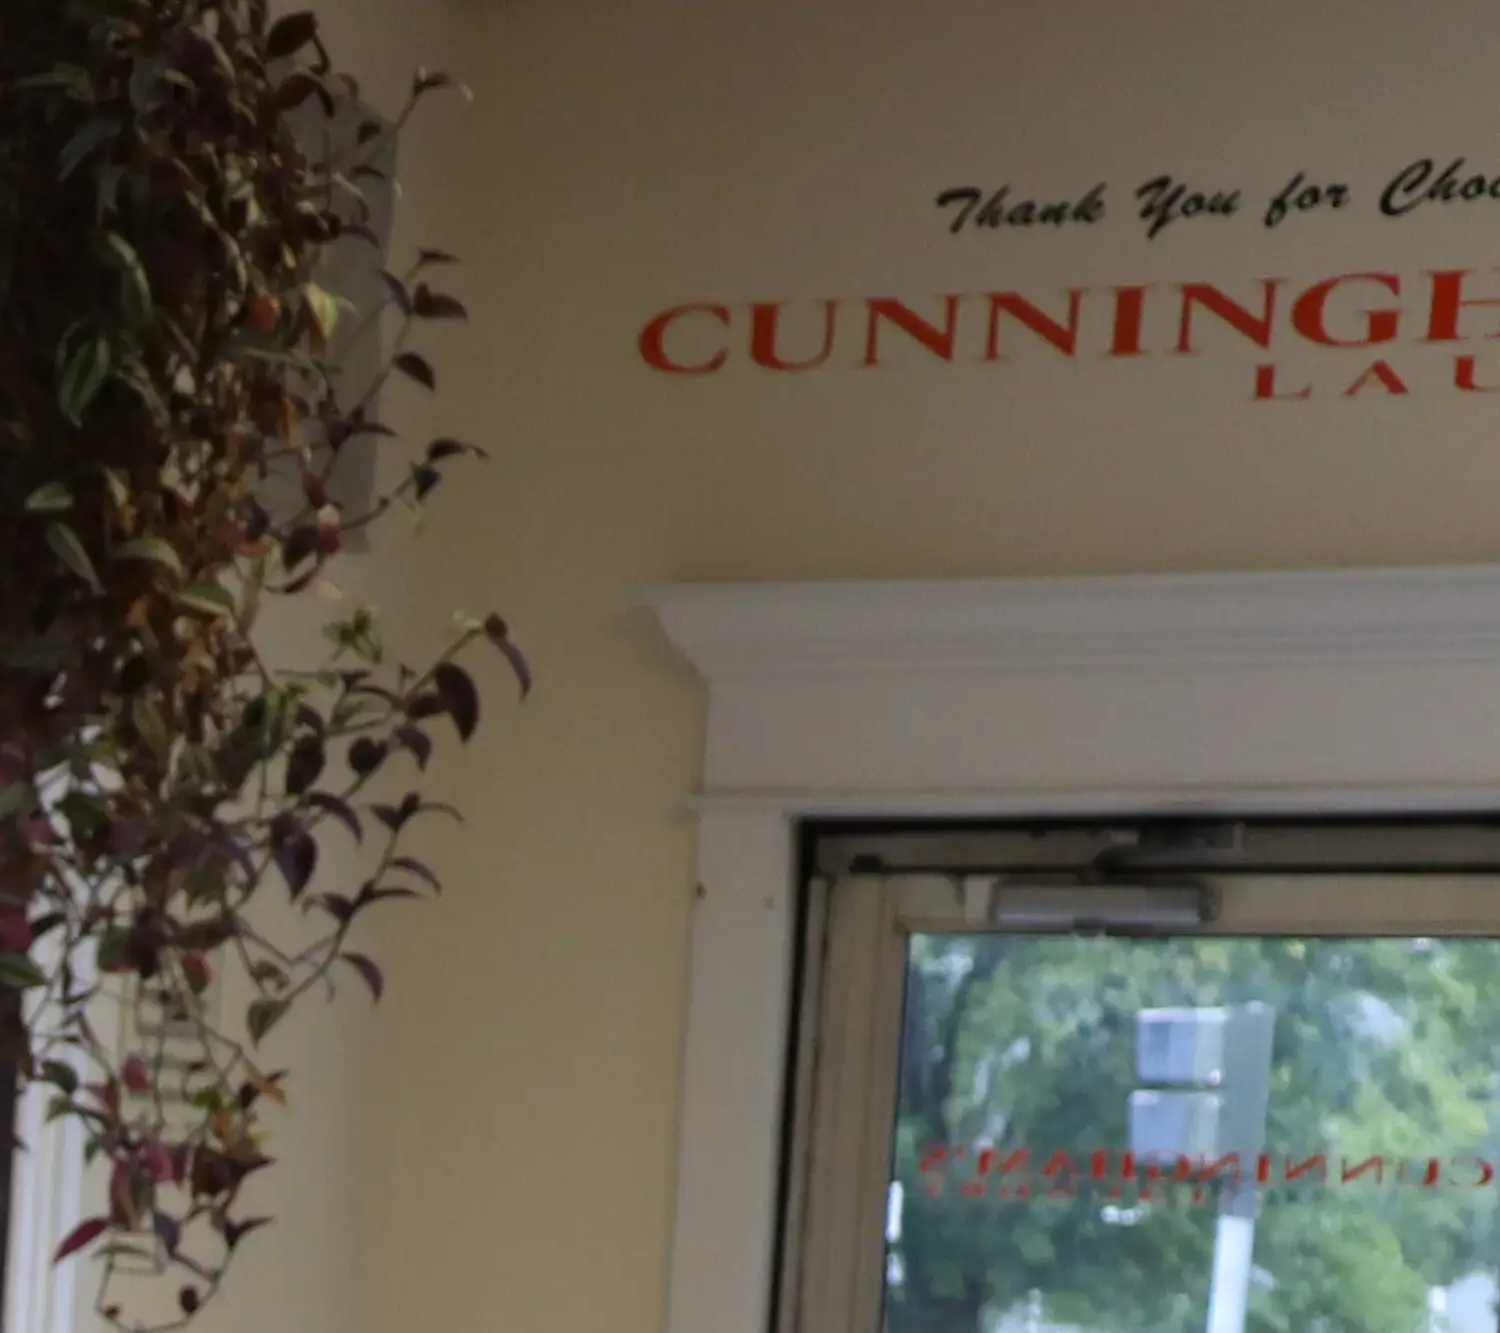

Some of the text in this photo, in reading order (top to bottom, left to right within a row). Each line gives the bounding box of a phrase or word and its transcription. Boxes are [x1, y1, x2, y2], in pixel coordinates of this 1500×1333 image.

[936, 183, 1106, 235] Thank
[1134, 173, 1242, 240] You
[1264, 171, 1350, 229] for
